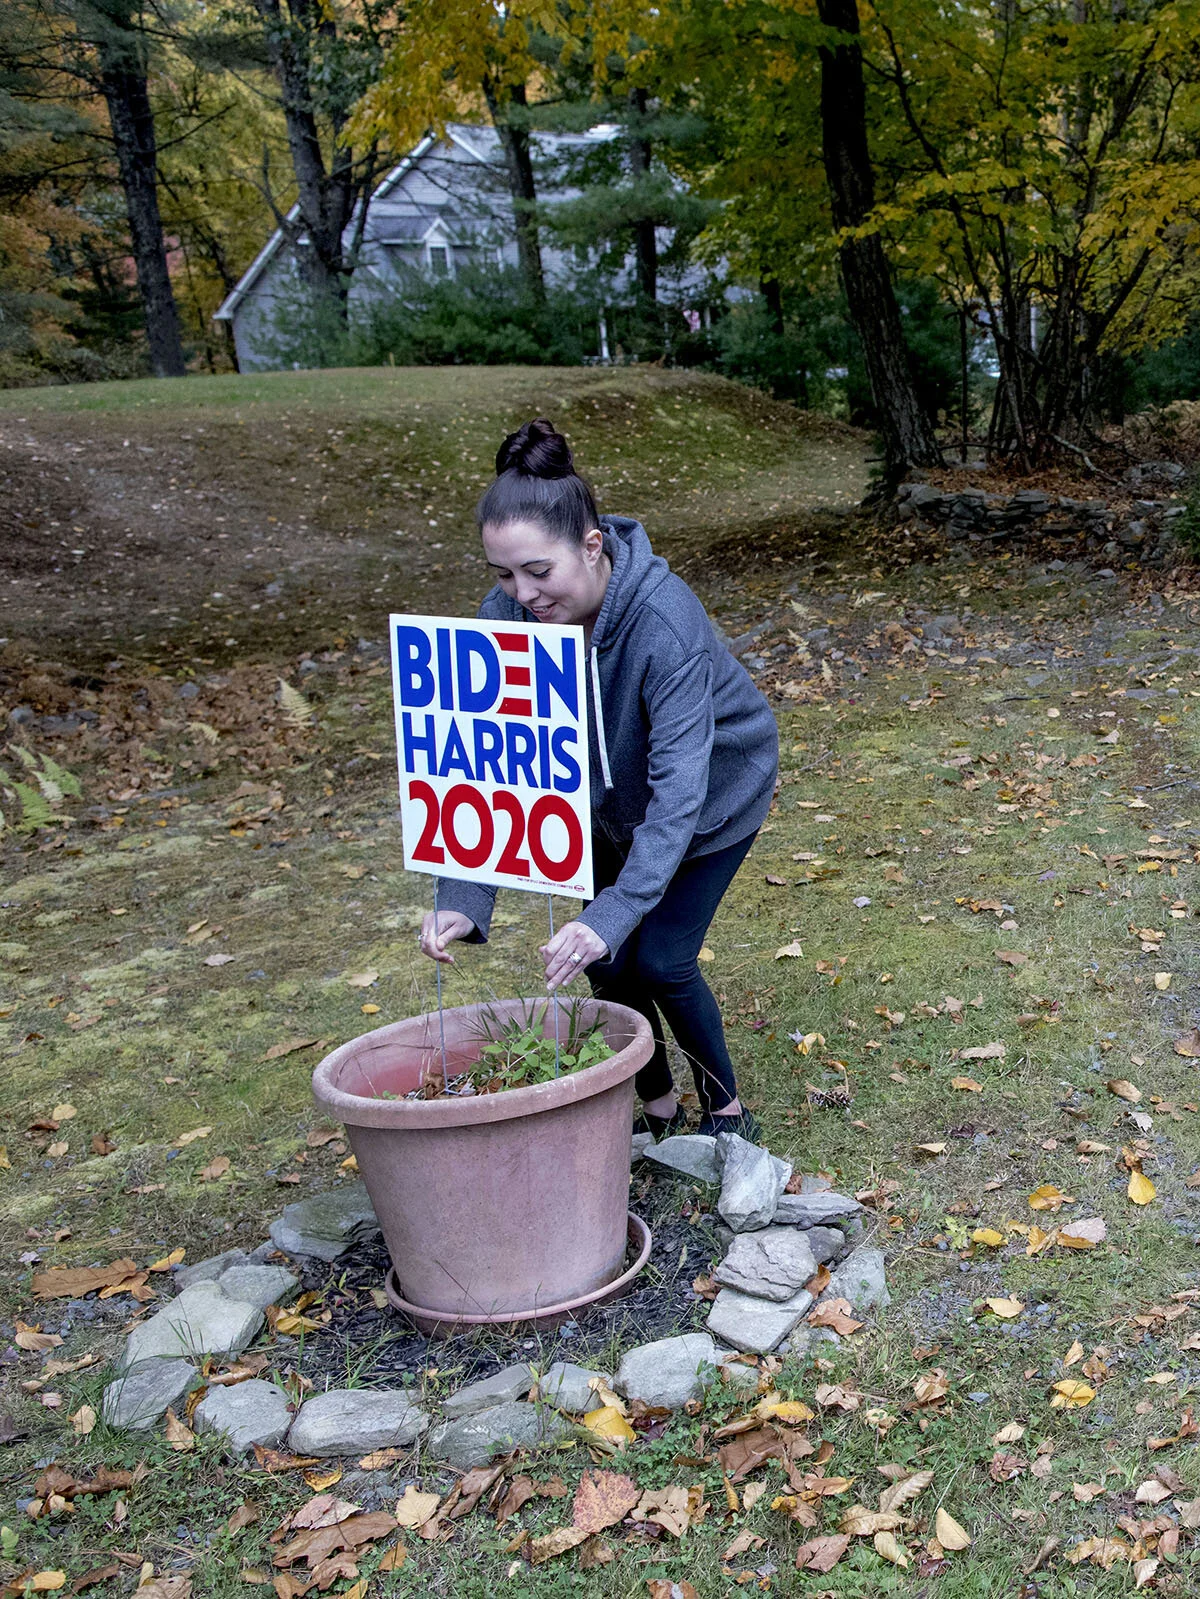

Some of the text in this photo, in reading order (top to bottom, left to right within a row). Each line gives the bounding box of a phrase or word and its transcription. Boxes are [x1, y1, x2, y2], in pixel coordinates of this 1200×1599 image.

[397, 625, 579, 722] BIDEN
[402, 711, 582, 794] HARRIS
[408, 779, 584, 883] 2020
